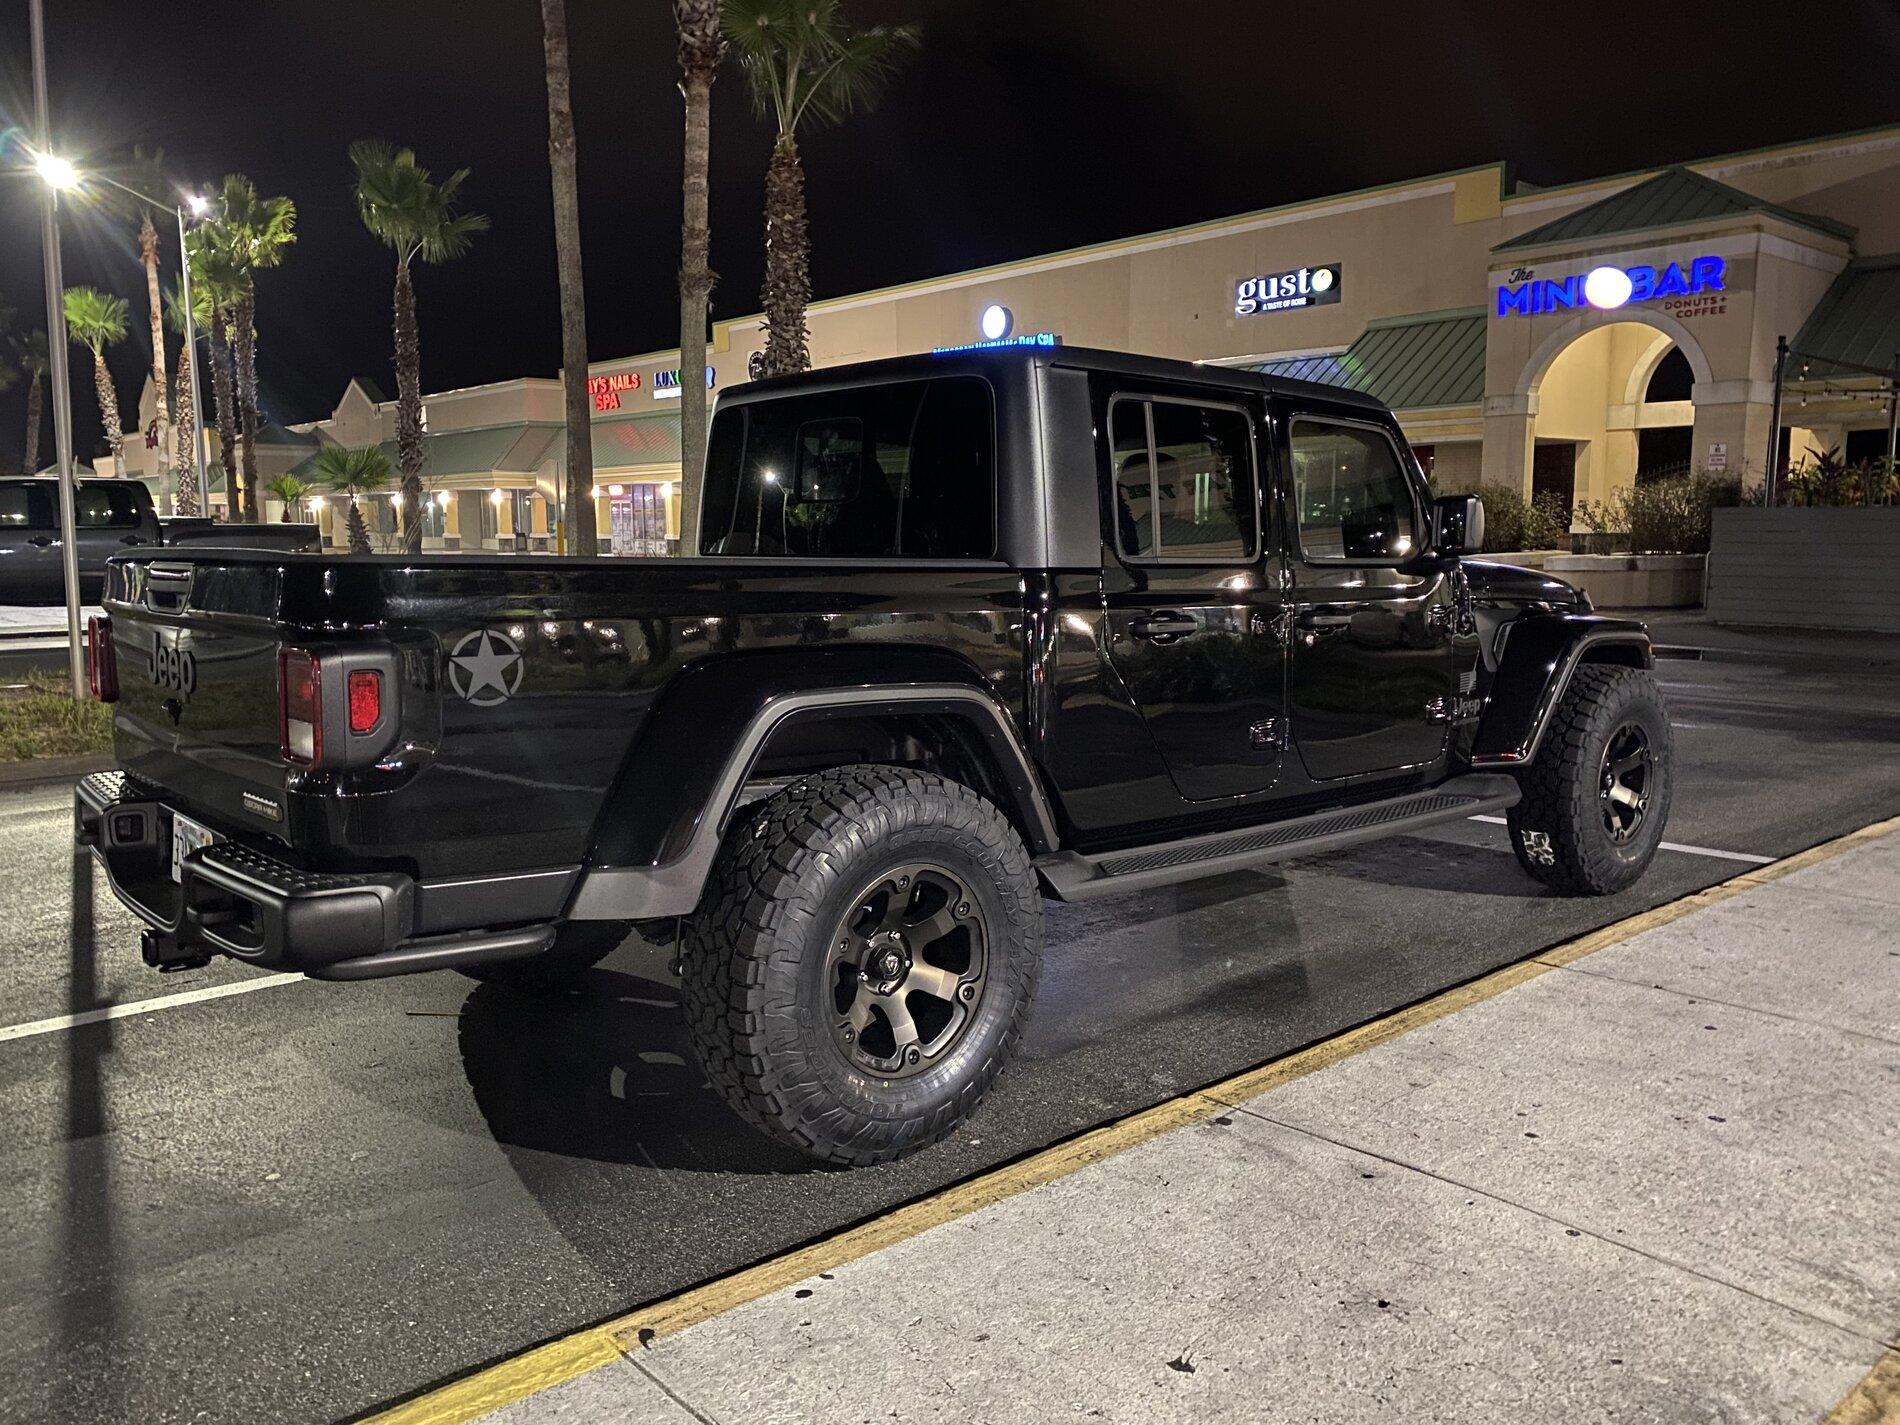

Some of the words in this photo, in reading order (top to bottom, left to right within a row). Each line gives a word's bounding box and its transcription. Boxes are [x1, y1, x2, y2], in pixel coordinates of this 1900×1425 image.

[1509, 267, 1534, 284] The
[1625, 255, 1726, 302] BAR
[1235, 268, 1333, 314] gusto
[1664, 296, 1718, 310] DONUTS
[1676, 305, 1727, 318] COFFEE
[609, 373, 640, 390] NAILS
[595, 393, 620, 411] SPA
[147, 630, 196, 703] Jeep
[1457, 697, 1480, 715] Jeep
